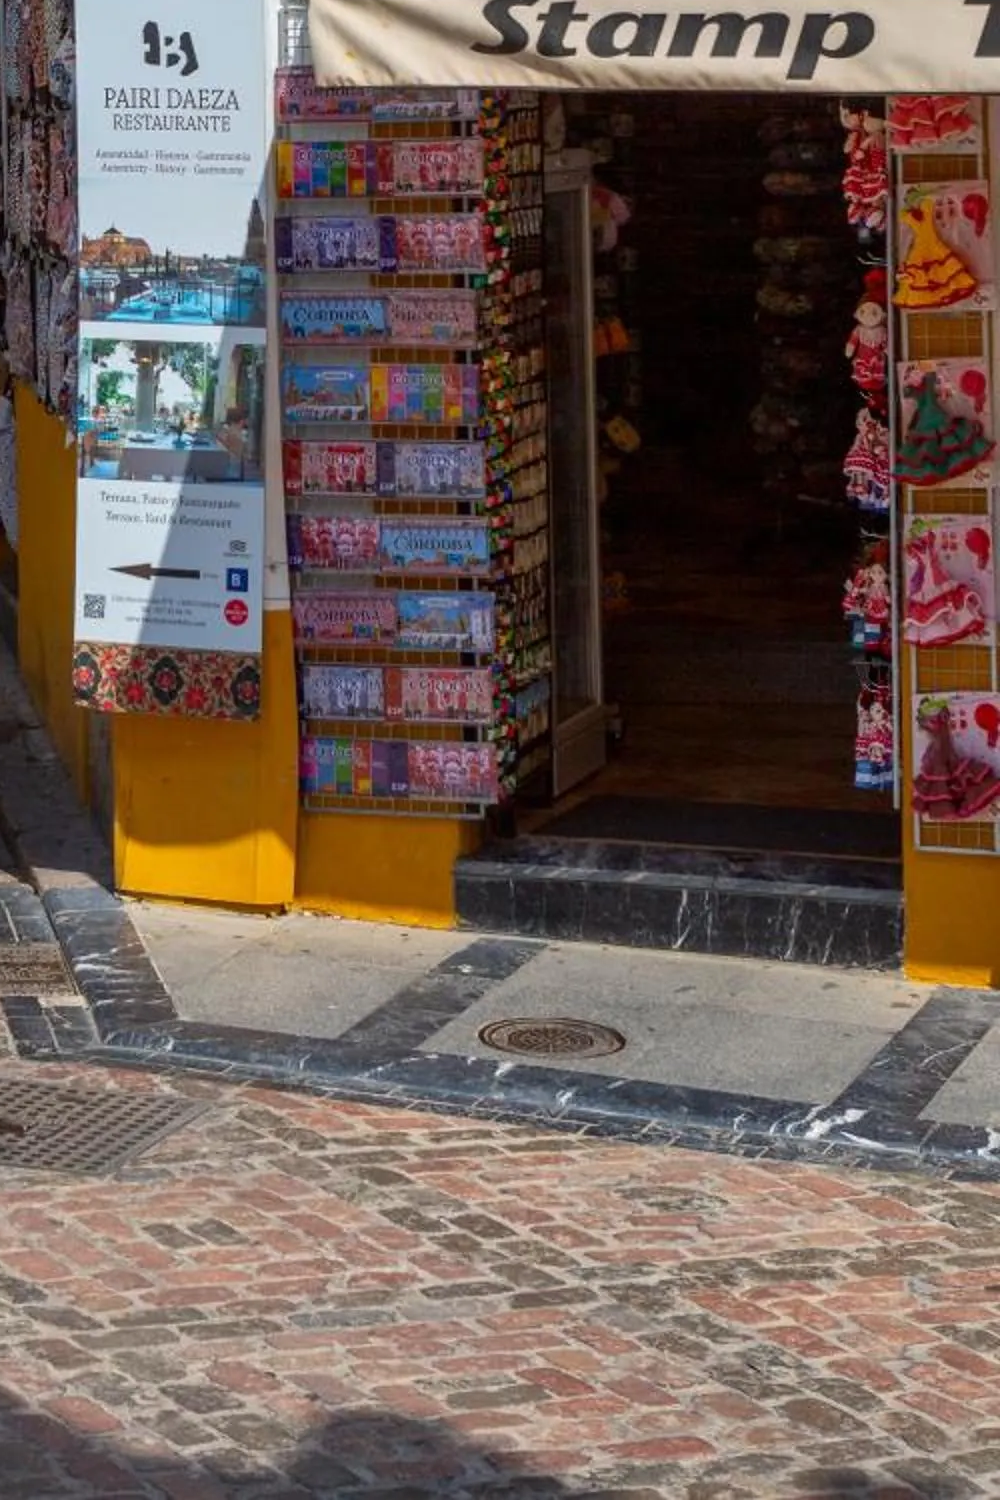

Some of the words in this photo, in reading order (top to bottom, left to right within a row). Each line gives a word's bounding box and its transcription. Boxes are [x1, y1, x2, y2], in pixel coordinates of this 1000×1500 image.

[103, 87, 160, 109] PAIRI
[167, 88, 240, 111] DAEZA
[113, 114, 232, 133] RESTAURANTE
